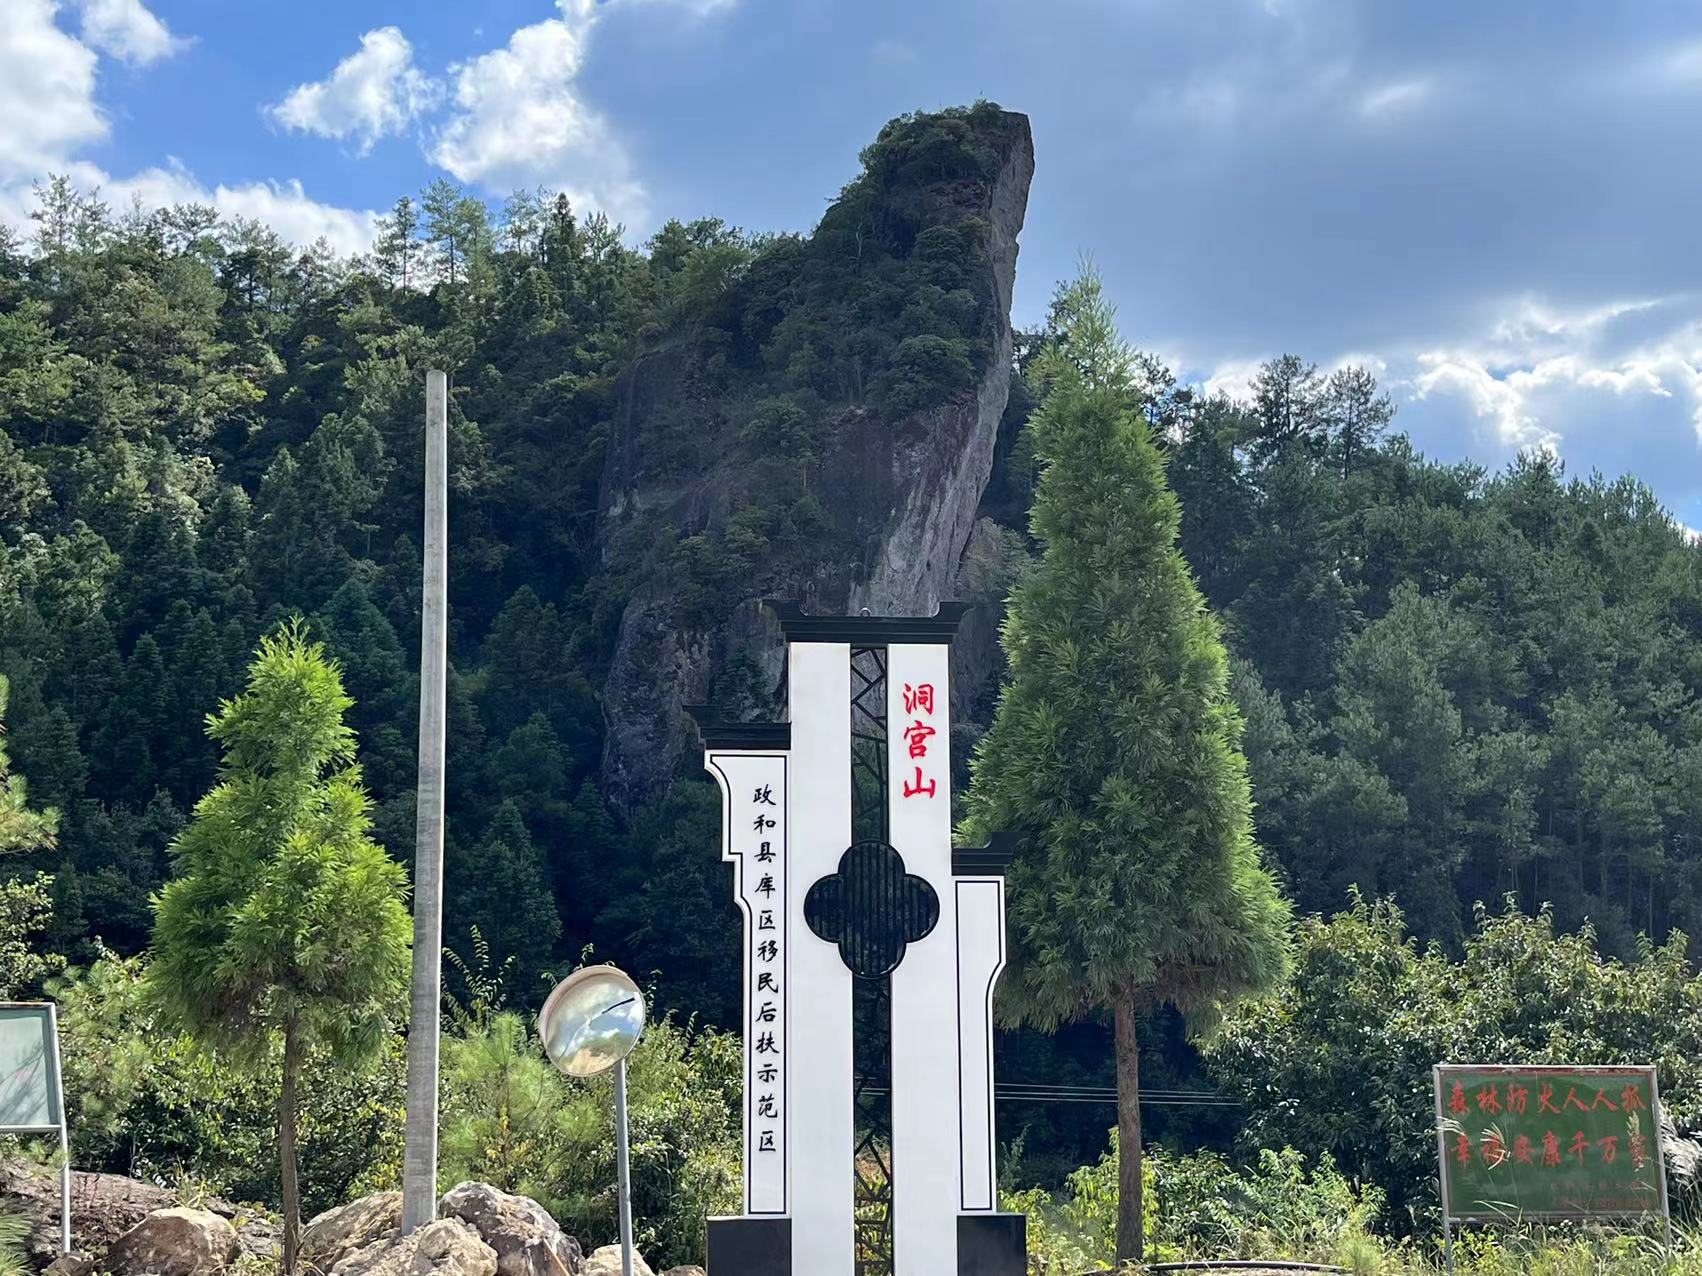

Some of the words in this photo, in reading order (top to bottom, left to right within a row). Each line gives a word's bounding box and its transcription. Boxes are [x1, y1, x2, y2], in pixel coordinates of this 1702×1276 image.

[902, 682, 936, 799] 洞宫山
[752, 783, 779, 1152] 政和县库区移民后扶示范区
